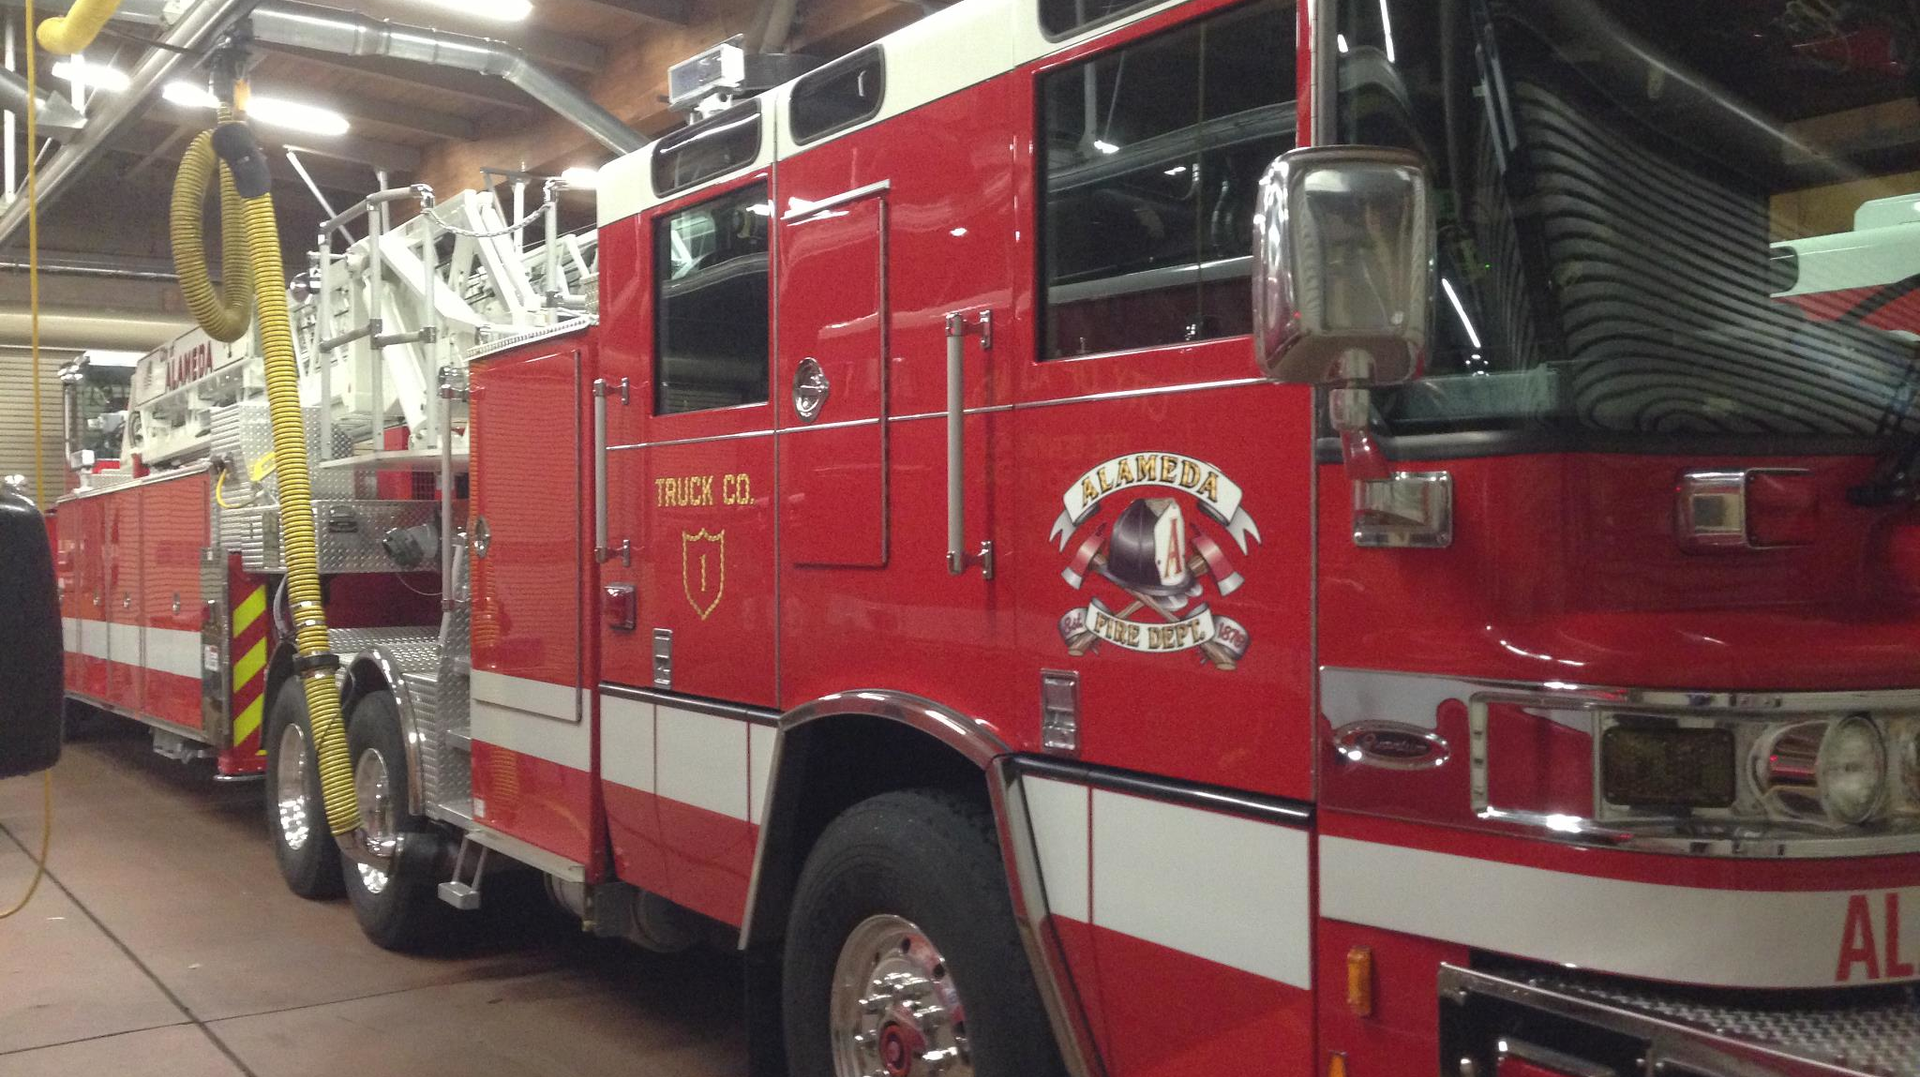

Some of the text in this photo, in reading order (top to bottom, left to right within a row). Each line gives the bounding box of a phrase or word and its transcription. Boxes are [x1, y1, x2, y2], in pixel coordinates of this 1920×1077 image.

[165, 339, 213, 392] ALAMEDA
[655, 473, 755, 507] TRUCK CO.
[1081, 454, 1219, 508] ALAMEDA
[1164, 518, 1183, 579] A
[1093, 610, 1206, 650] FIRE DEPT.
